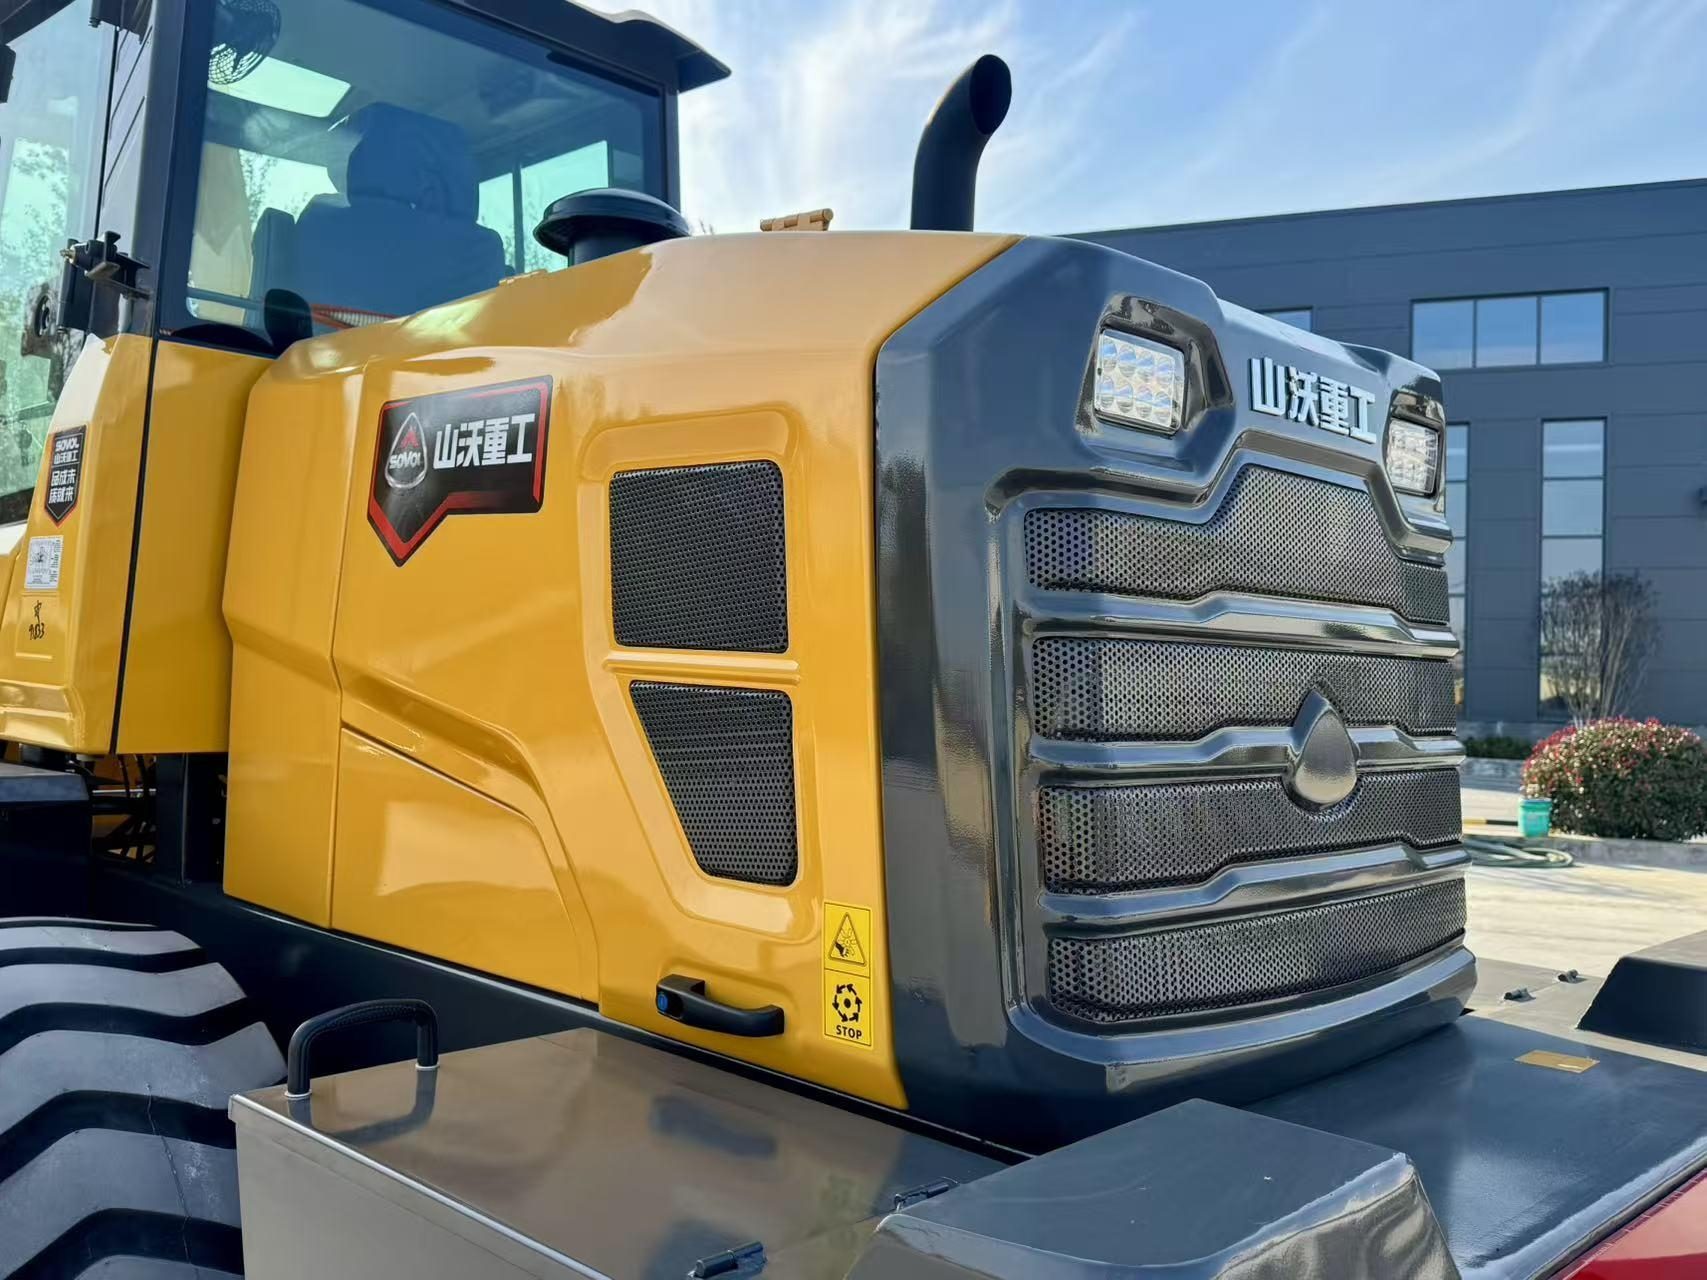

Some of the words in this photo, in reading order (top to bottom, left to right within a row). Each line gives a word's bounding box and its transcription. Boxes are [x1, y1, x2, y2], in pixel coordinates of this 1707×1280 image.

[1249, 357, 1377, 444] 山沃重工
[433, 413, 535, 470] 山沃重工
[836, 1025, 862, 1039] STOP
